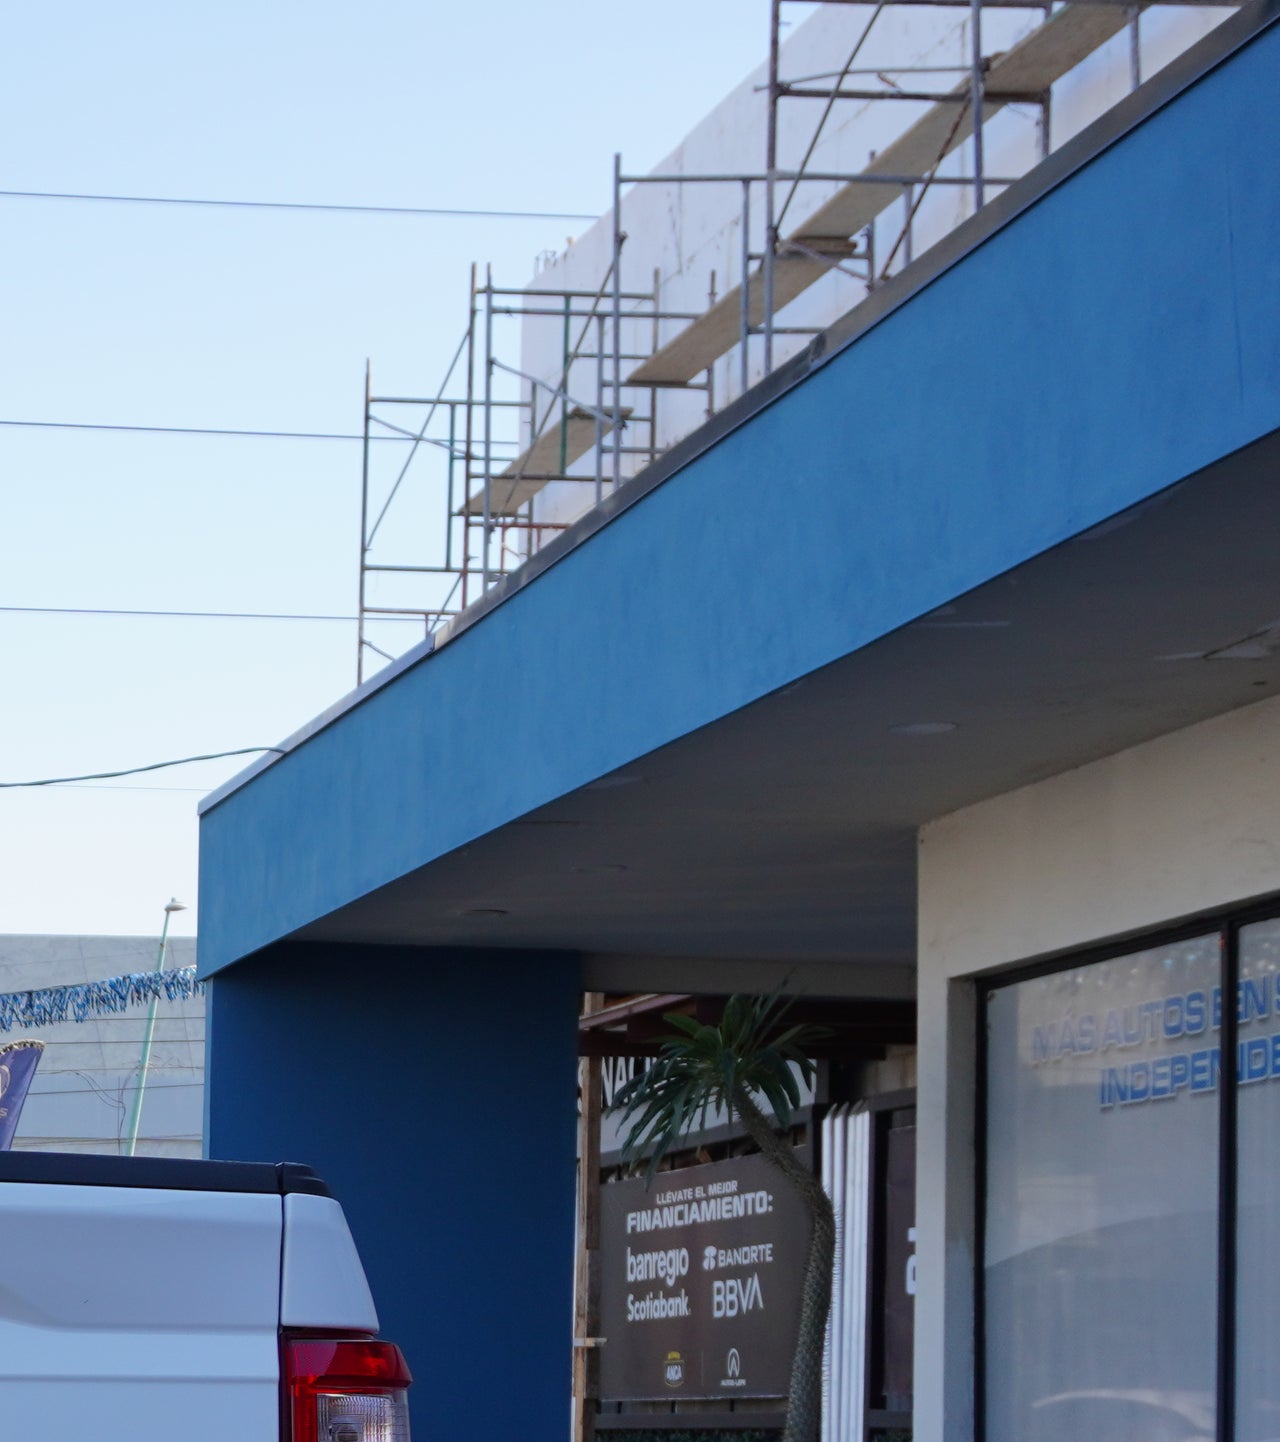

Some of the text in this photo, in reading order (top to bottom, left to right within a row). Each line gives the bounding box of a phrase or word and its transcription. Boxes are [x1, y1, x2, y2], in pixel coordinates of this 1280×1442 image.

[1099, 989, 1206, 1050] AUTOS
[627, 1191, 774, 1234] FINANCIAMIENTO:
[656, 1180, 738, 1205] LLÉVATE EL MEJOR
[627, 1247, 689, 1287] banregio
[718, 1243, 774, 1268] BANORTE
[627, 1288, 689, 1322] Scotiabank
[712, 1272, 764, 1318] BBVA
